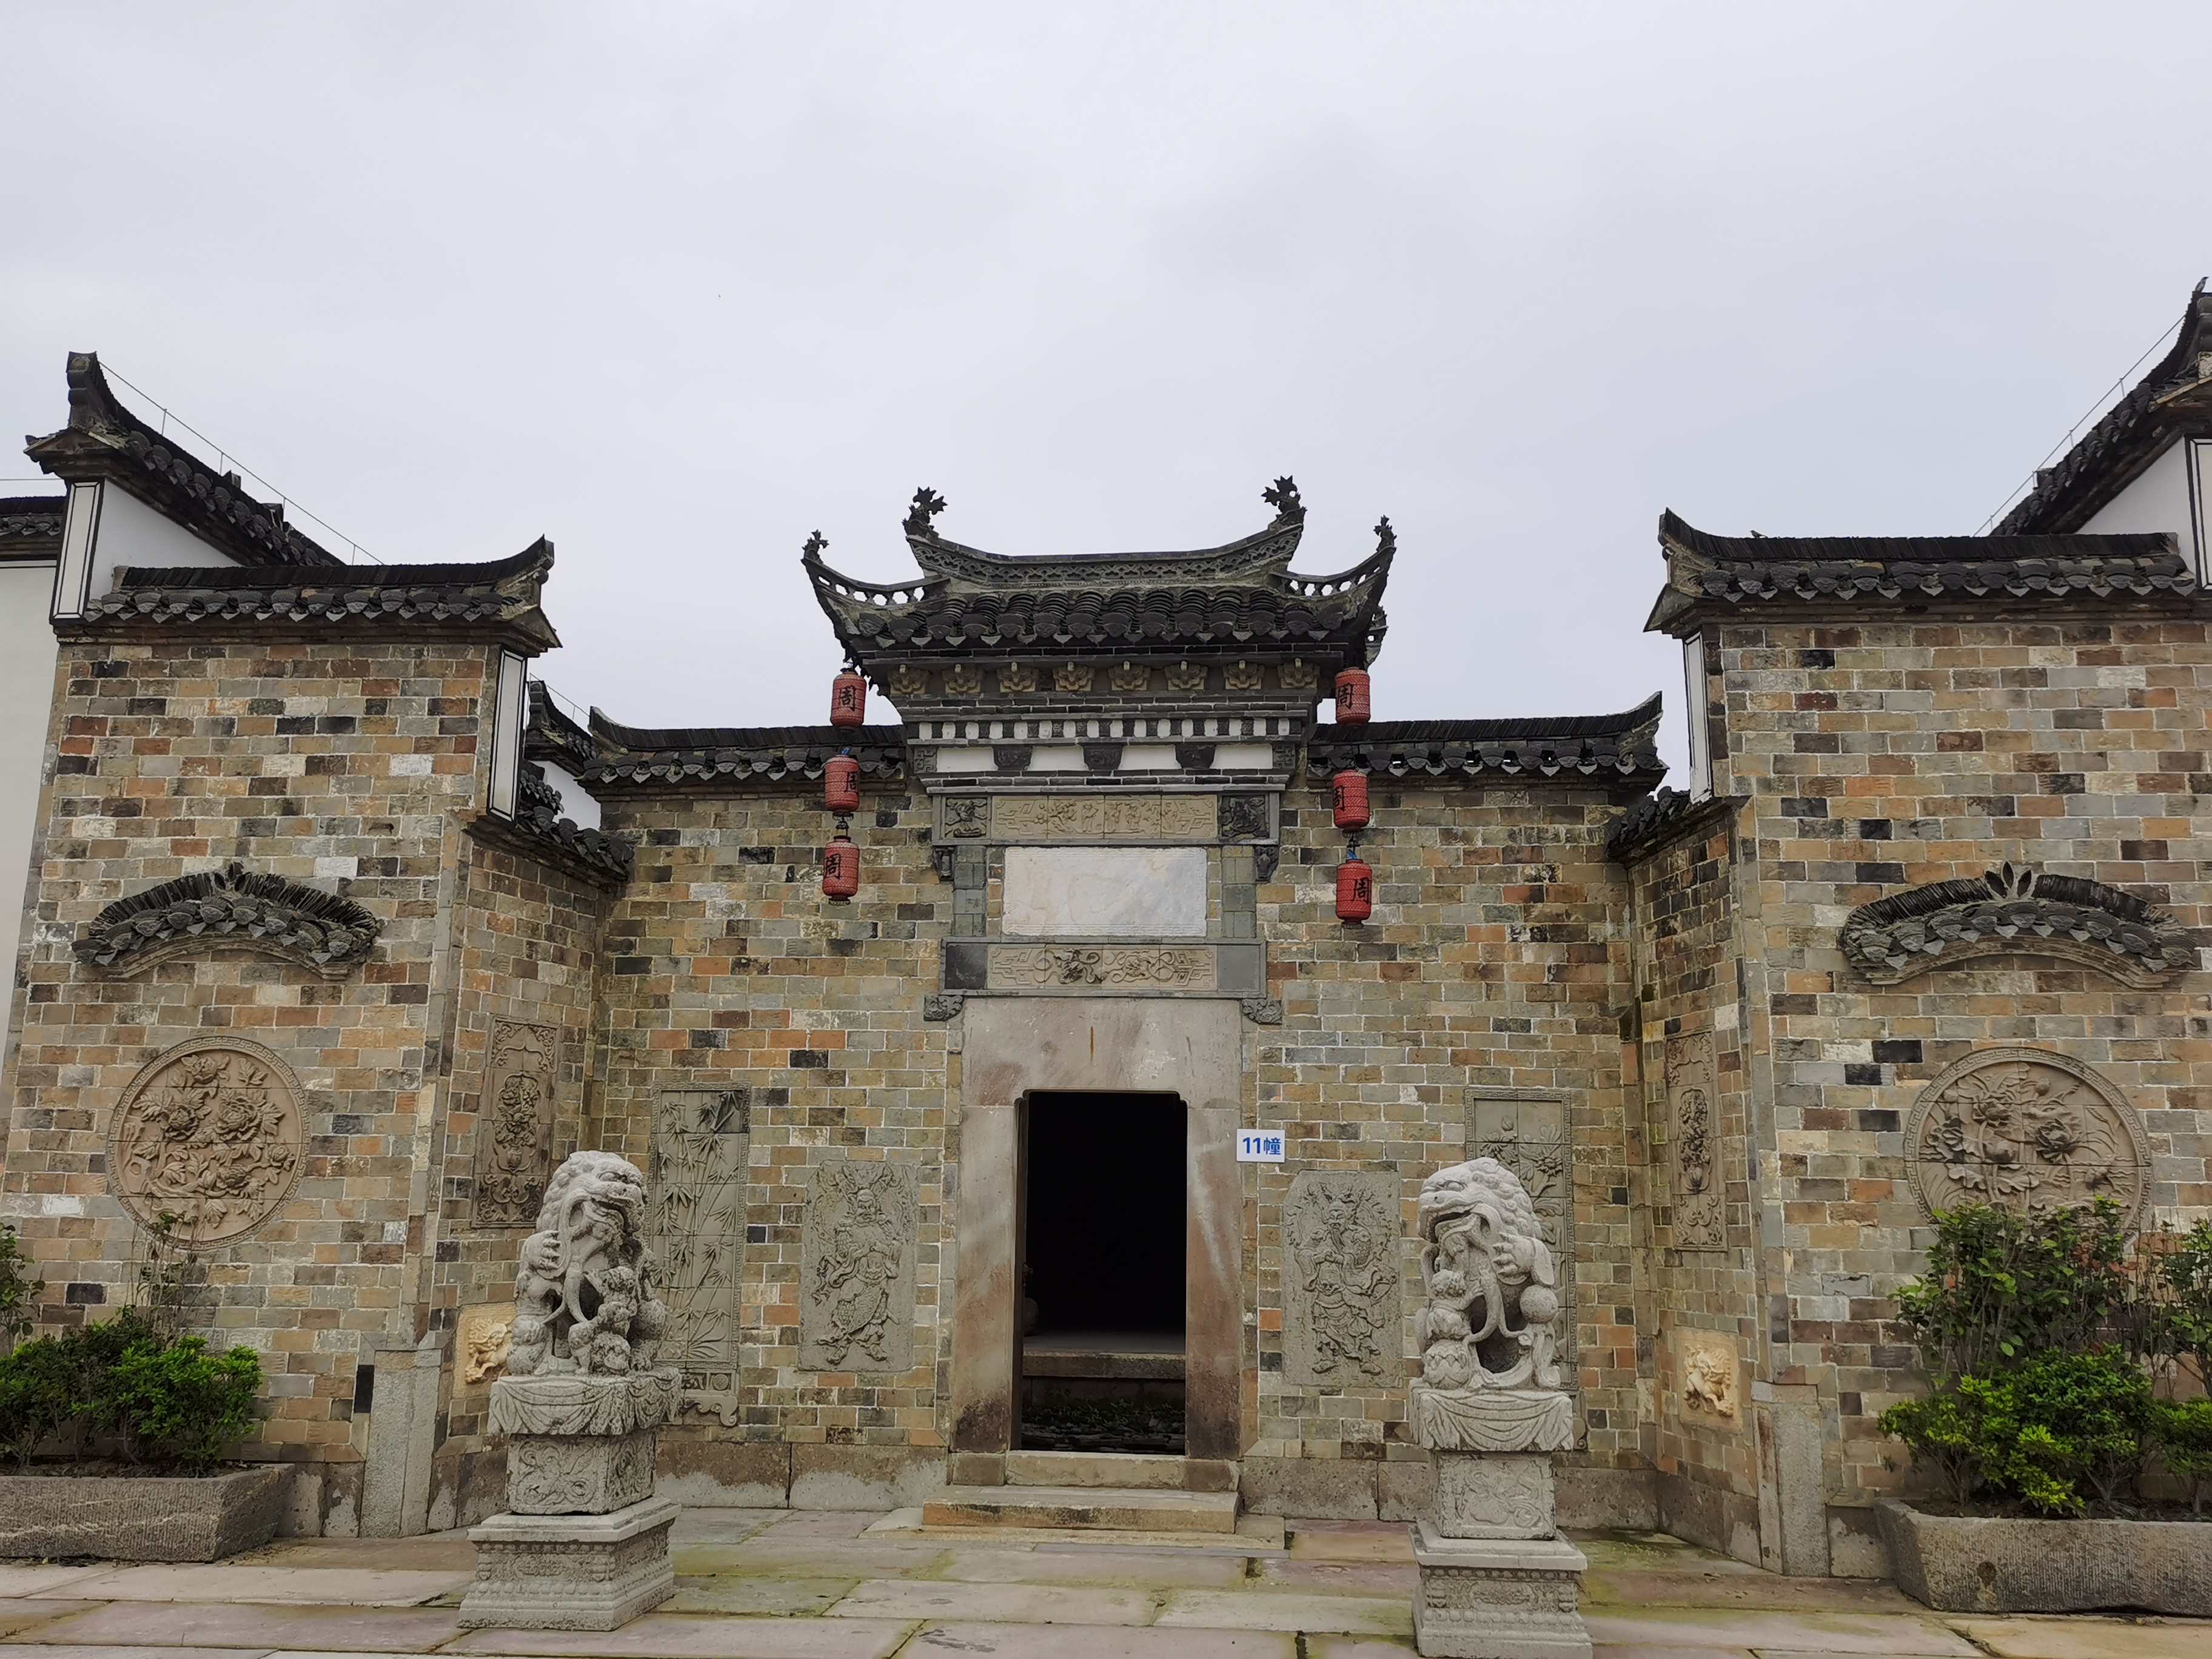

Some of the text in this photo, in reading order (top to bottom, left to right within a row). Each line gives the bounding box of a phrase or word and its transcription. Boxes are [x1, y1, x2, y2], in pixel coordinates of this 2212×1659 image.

[838, 685, 856, 712] 周
[1336, 682, 1353, 709] 周
[825, 853, 841, 880] 周
[1352, 877, 1370, 904] 周
[1242, 1137, 1281, 1155] 11幢
